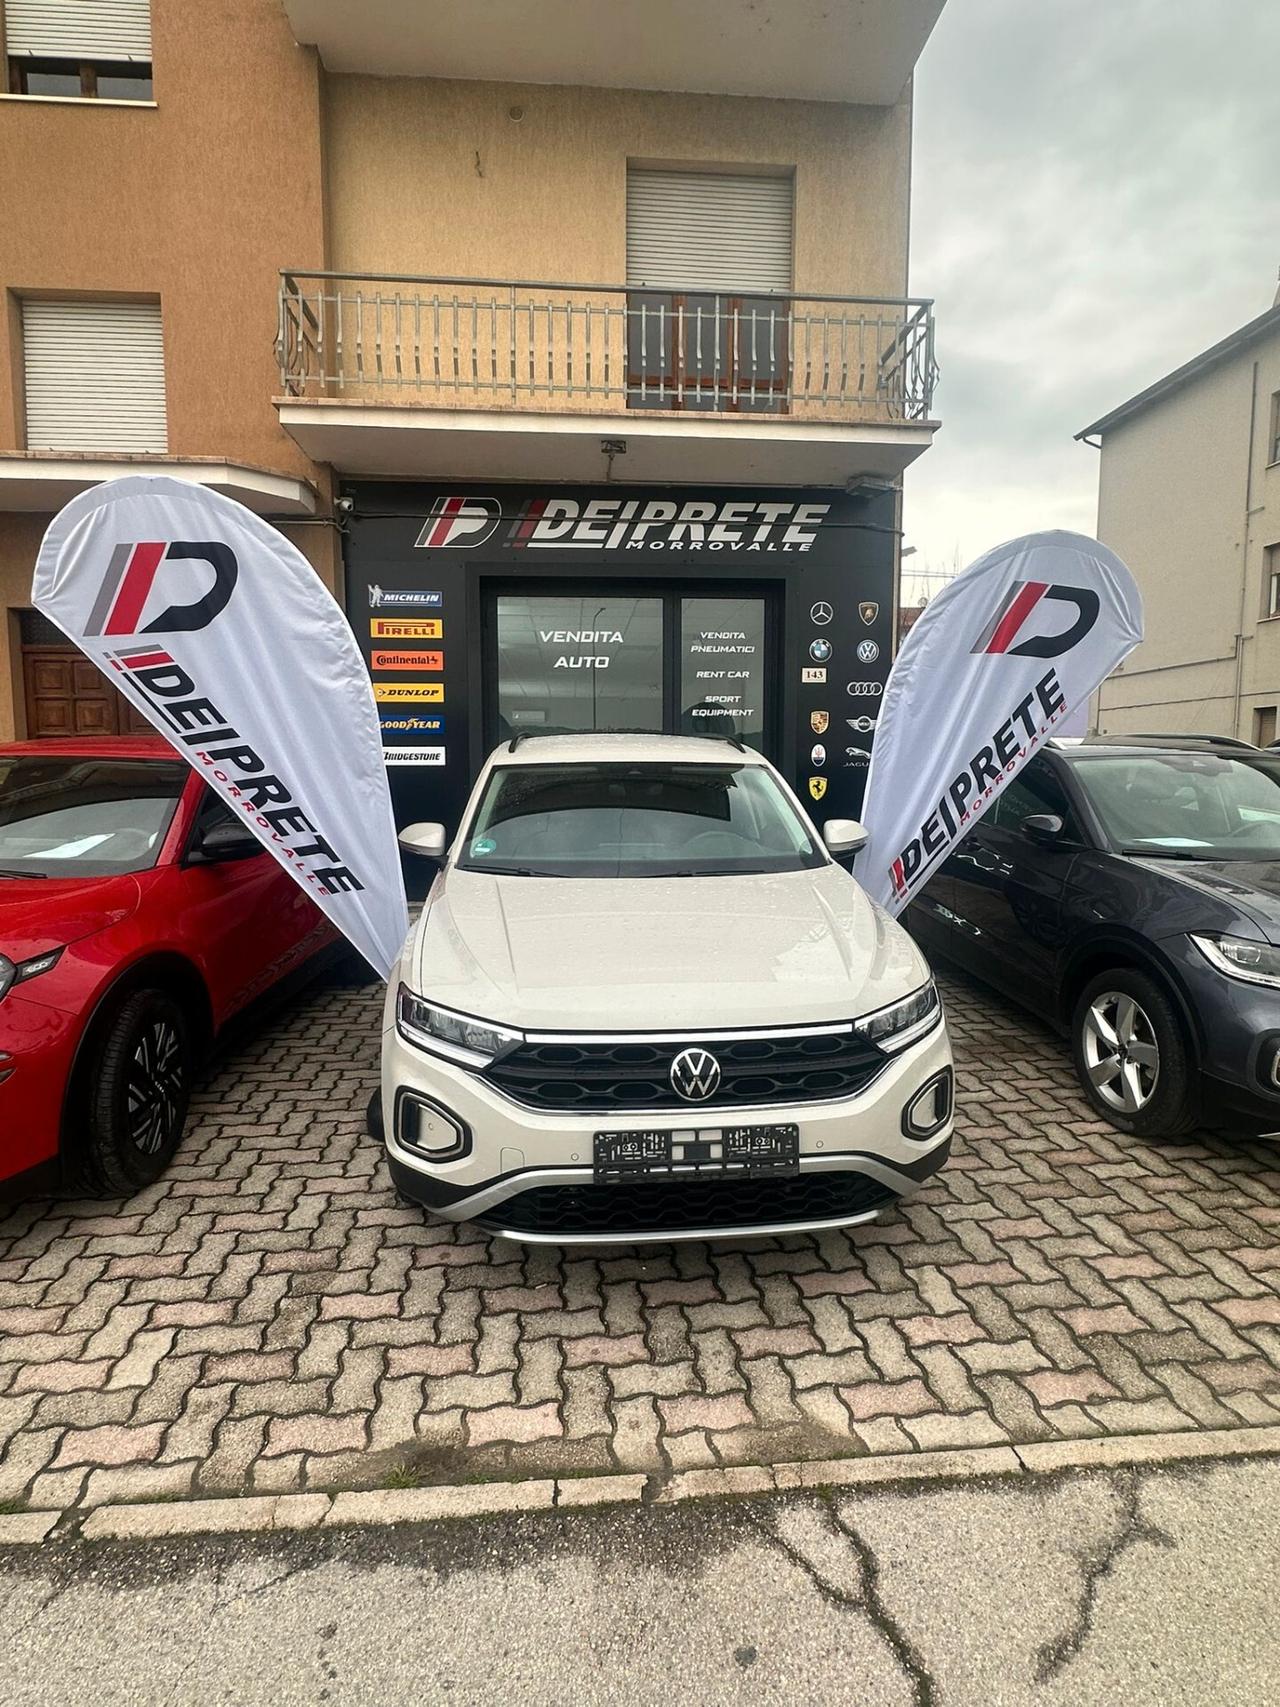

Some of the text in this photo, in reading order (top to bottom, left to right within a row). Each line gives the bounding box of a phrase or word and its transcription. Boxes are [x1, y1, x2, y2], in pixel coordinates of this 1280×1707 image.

[625, 541, 812, 551] MORROVALLE
[384, 594, 439, 602] MICHELIN
[377, 622, 435, 635] PIRELLI
[540, 631, 624, 643] VENDITA
[700, 631, 746, 639] VENDITA
[690, 645, 755, 653] PNEUMATICI
[376, 655, 430, 665] Continental
[554, 656, 610, 668] AUTO
[806, 670, 823, 679] 143
[705, 695, 742, 703] SPORT
[691, 709, 754, 717] EQUIPMENT
[960, 702, 1067, 827] MORROVALLE
[196, 751, 330, 897] MORROVALLE
